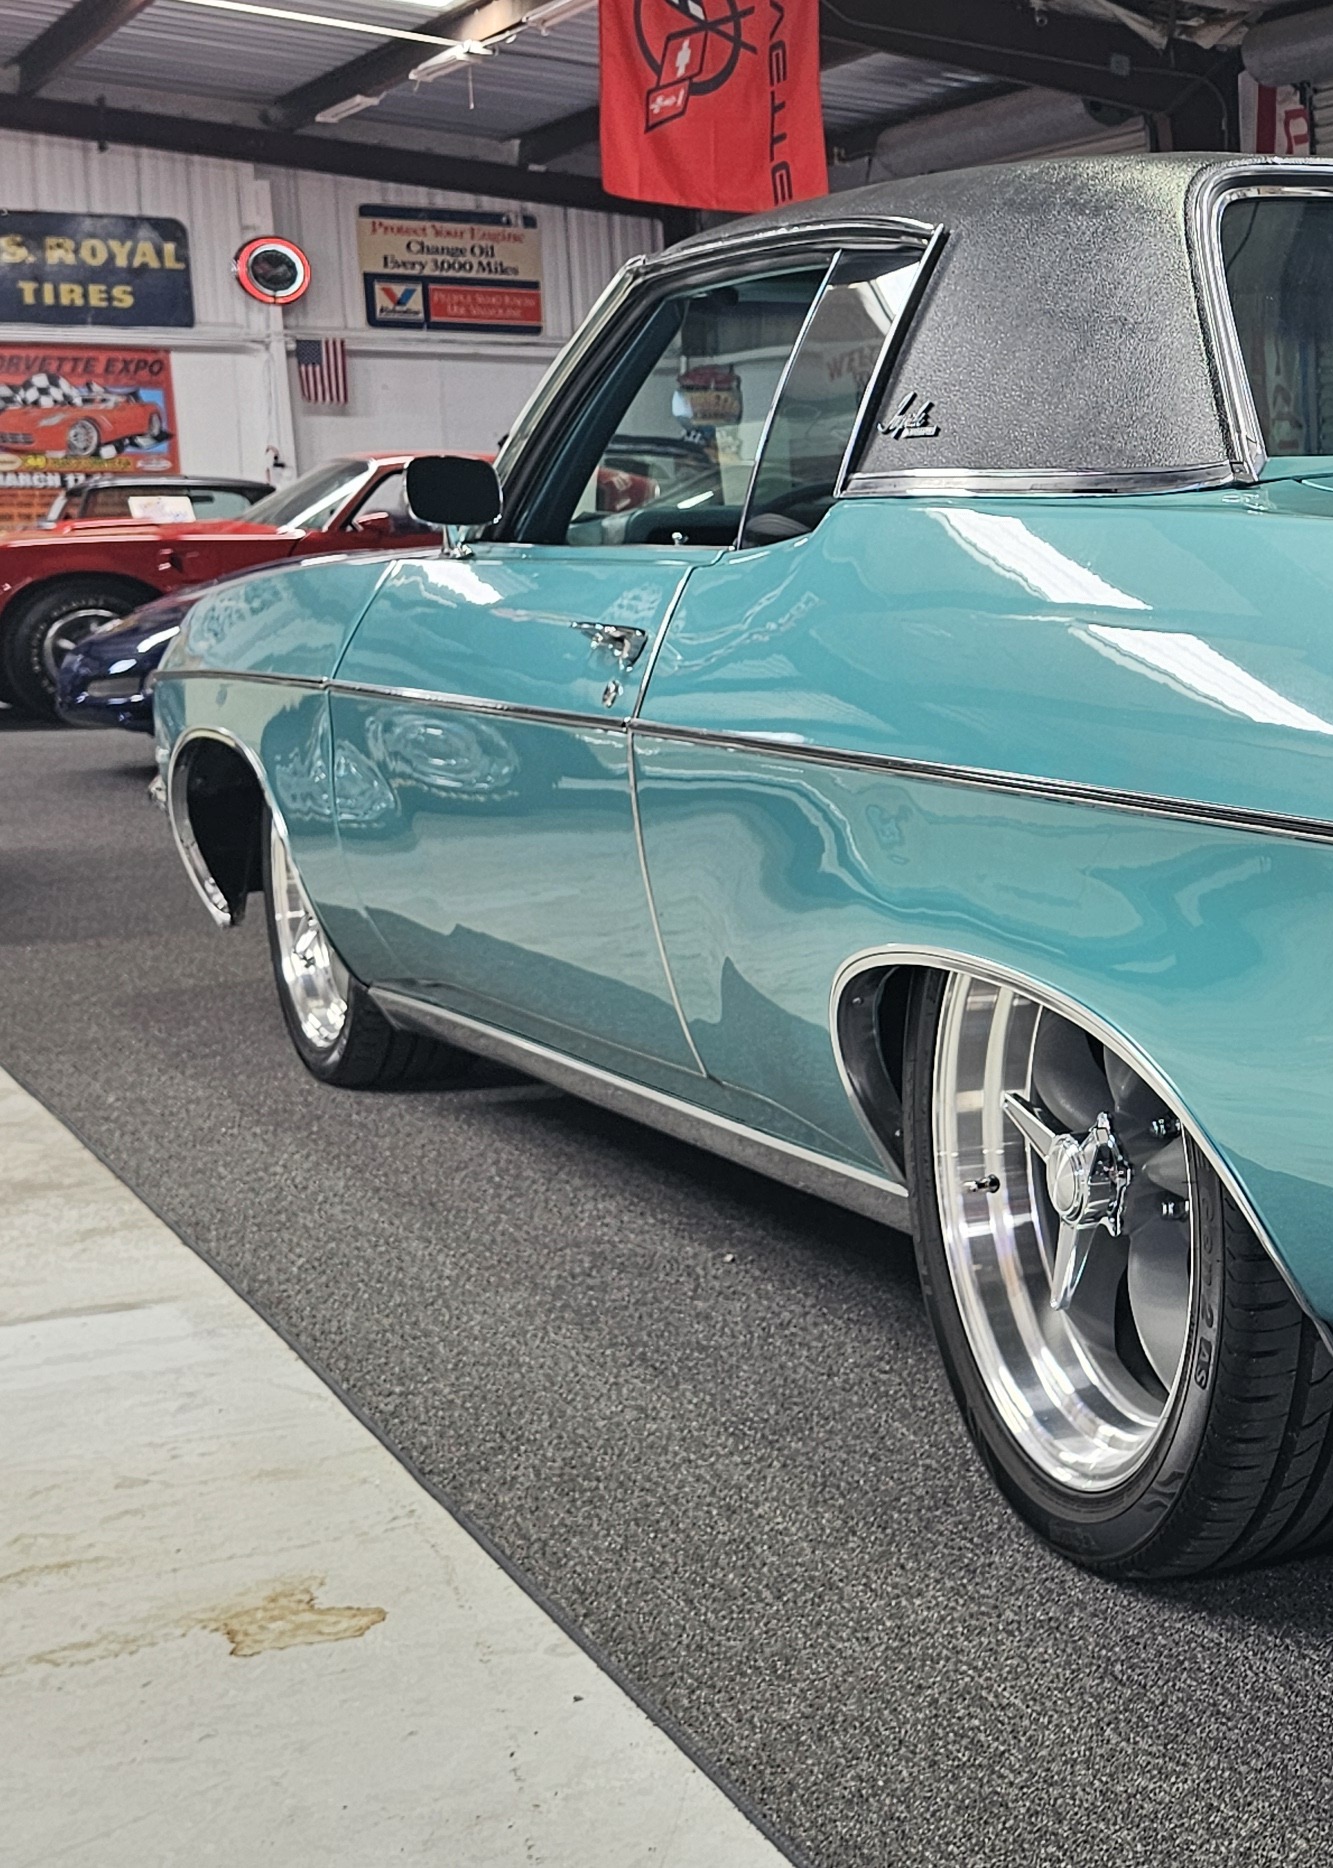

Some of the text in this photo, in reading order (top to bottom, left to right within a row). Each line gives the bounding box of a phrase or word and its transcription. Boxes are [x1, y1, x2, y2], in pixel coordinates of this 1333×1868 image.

[371, 220, 525, 244] Protect Your Engine
[45, 236, 186, 270] ROYAL
[405, 239, 496, 258] Change Oil
[383, 254, 428, 273] Every
[476, 260, 520, 276] Miles
[17, 280, 135, 309] TIRES
[104, 358, 164, 377] EXPO
